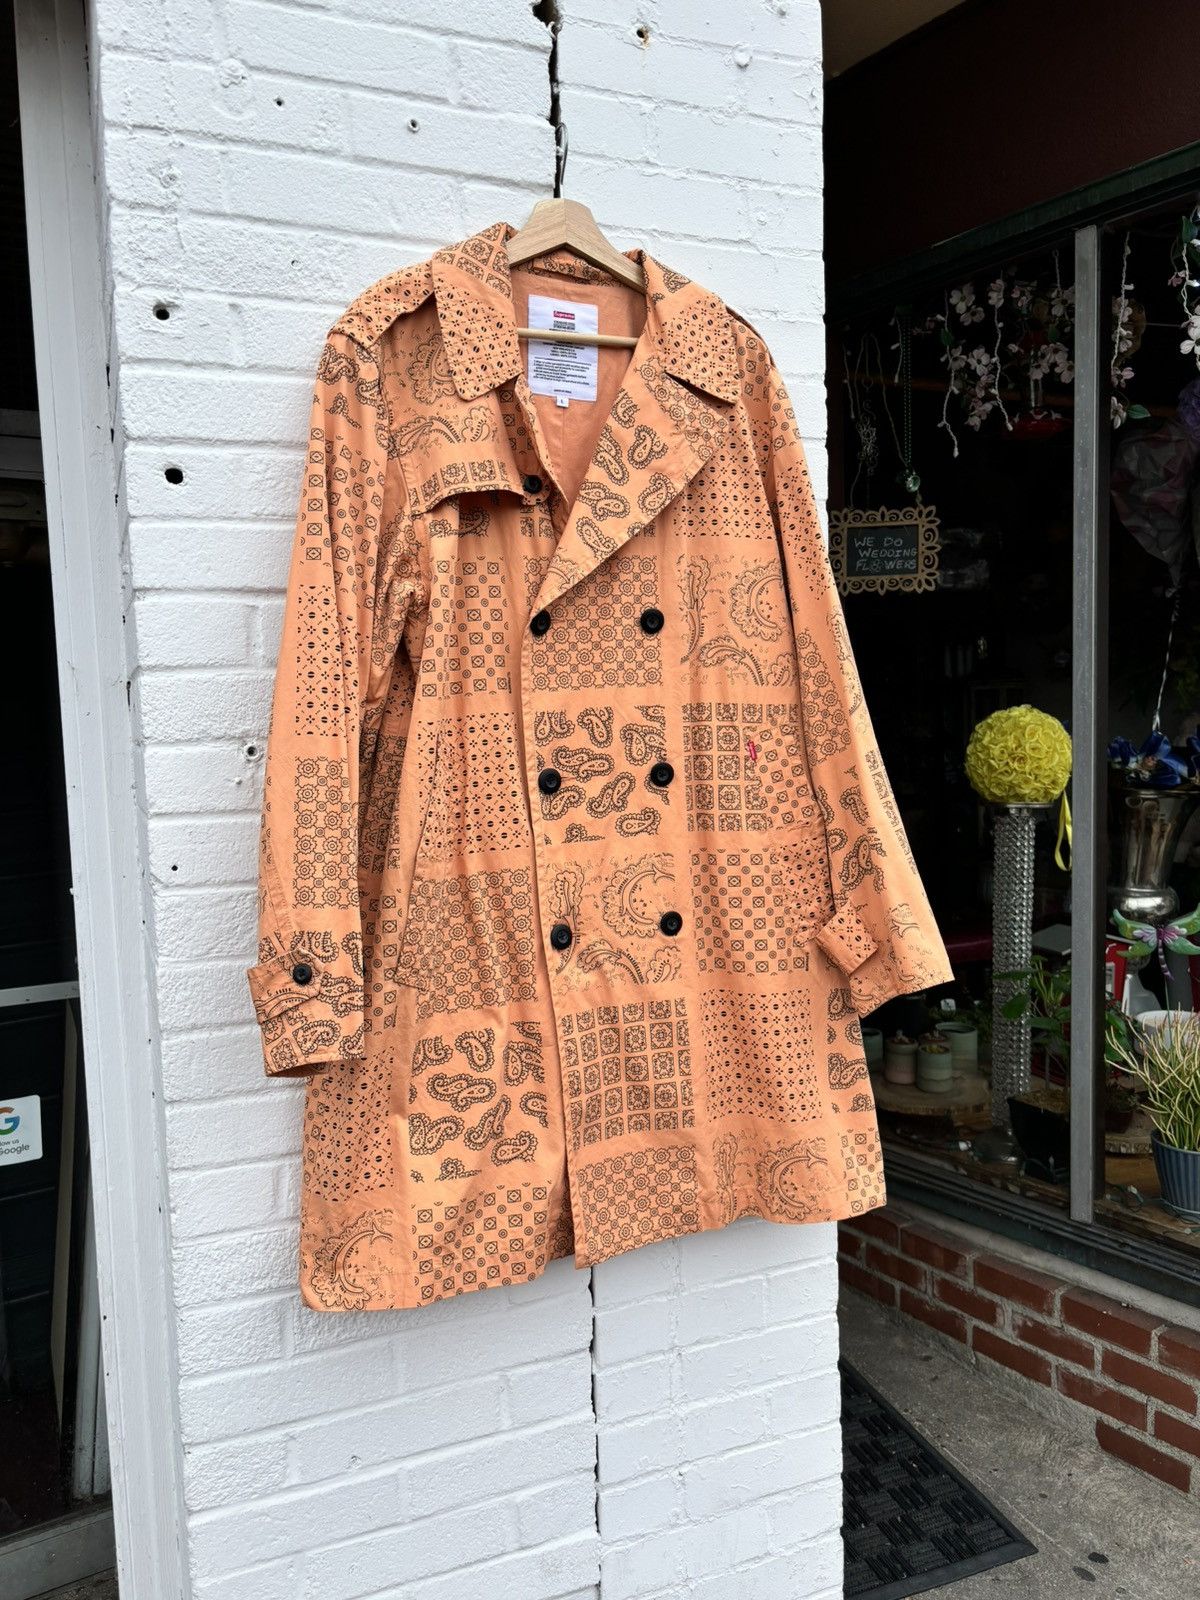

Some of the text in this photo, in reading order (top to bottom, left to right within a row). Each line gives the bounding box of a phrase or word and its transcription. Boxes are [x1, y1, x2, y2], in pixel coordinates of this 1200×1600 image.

[854, 537, 903, 547] WE DO
[859, 547, 917, 557] WEDDING
